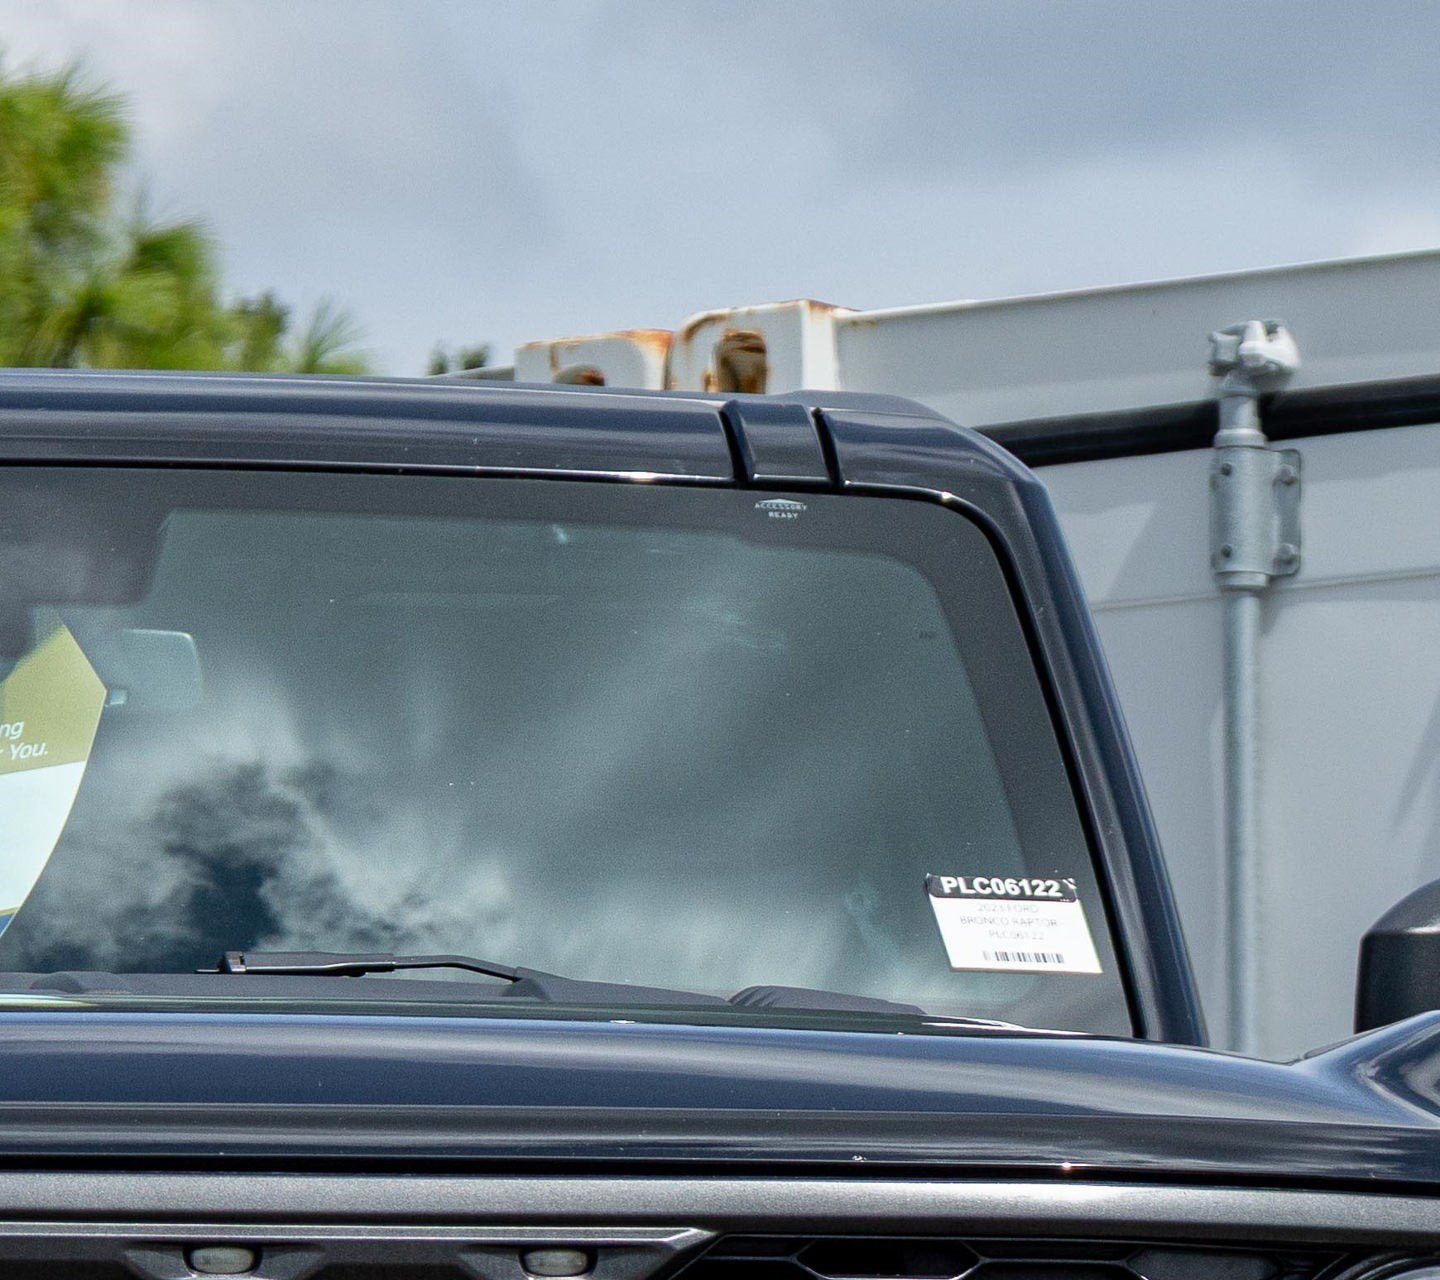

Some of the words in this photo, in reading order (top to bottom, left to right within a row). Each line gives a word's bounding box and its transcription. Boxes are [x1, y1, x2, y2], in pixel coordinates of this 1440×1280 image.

[754, 502, 808, 511] ACCESSORY
[768, 511, 799, 519] READY
[9, 741, 49, 761] You.
[939, 876, 1063, 897] PLC06122
